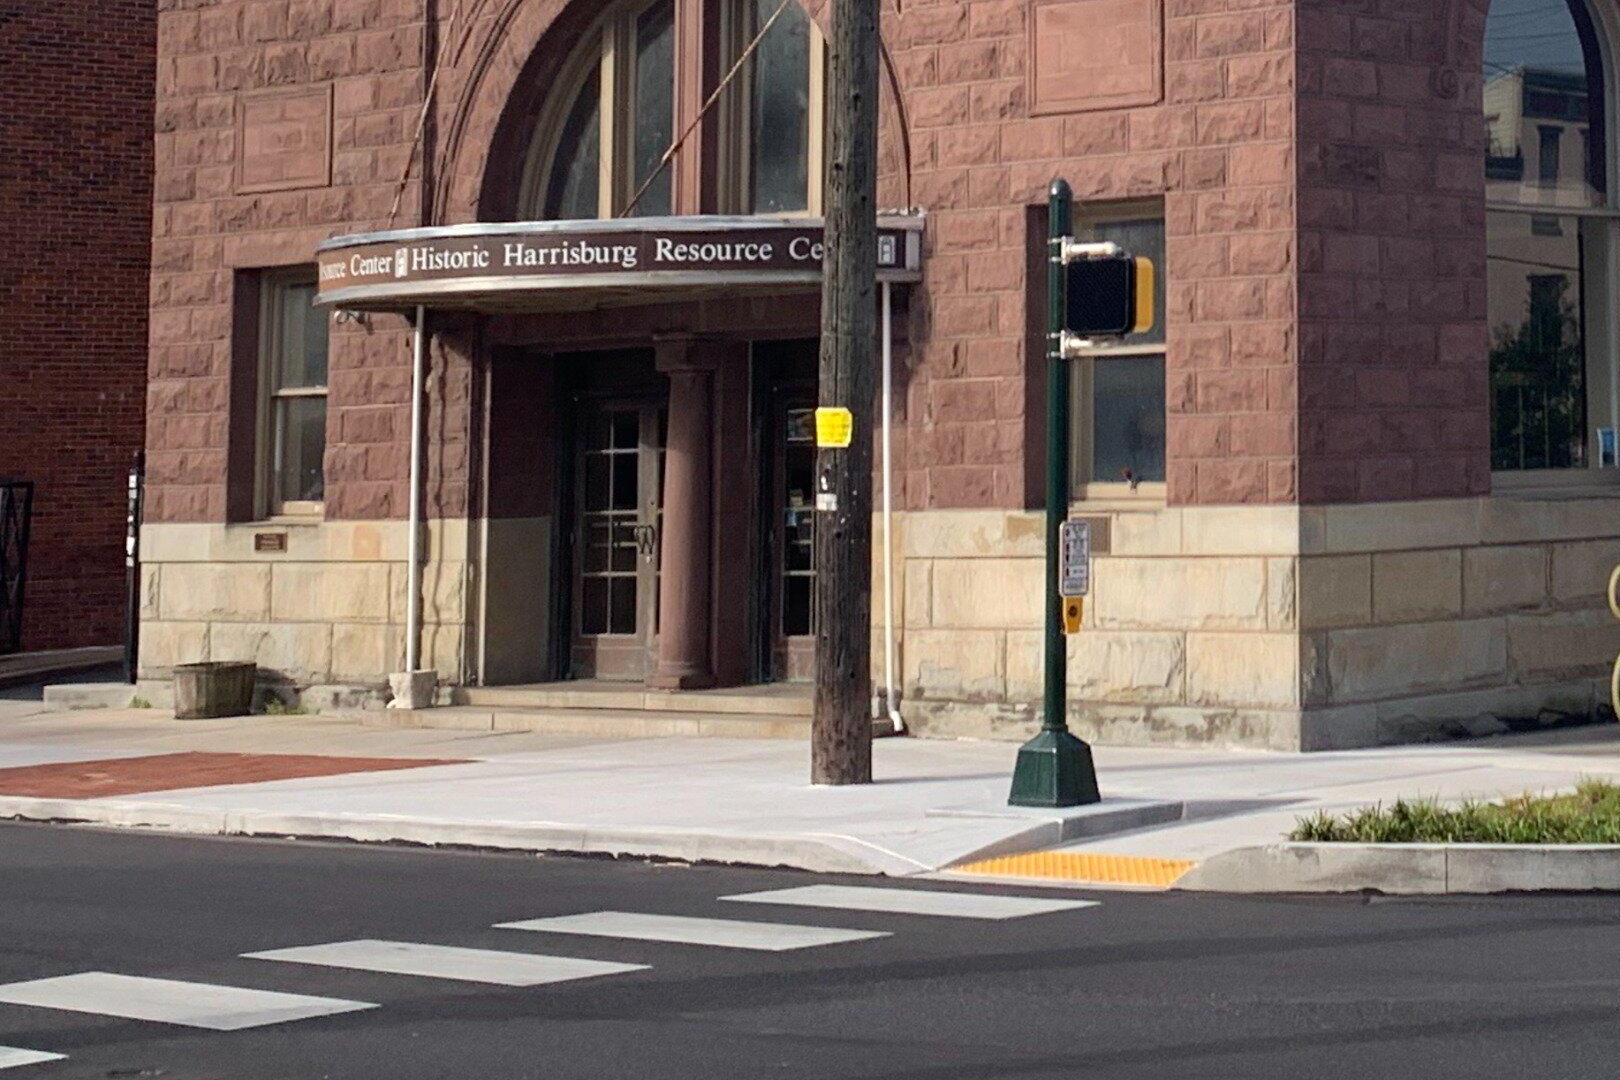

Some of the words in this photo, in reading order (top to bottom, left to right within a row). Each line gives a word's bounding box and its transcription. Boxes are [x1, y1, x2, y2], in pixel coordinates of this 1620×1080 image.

[350, 253, 393, 277] Center
[411, 245, 490, 271] Historic
[503, 241, 638, 268] Harrisburg
[654, 237, 773, 262] Resource
